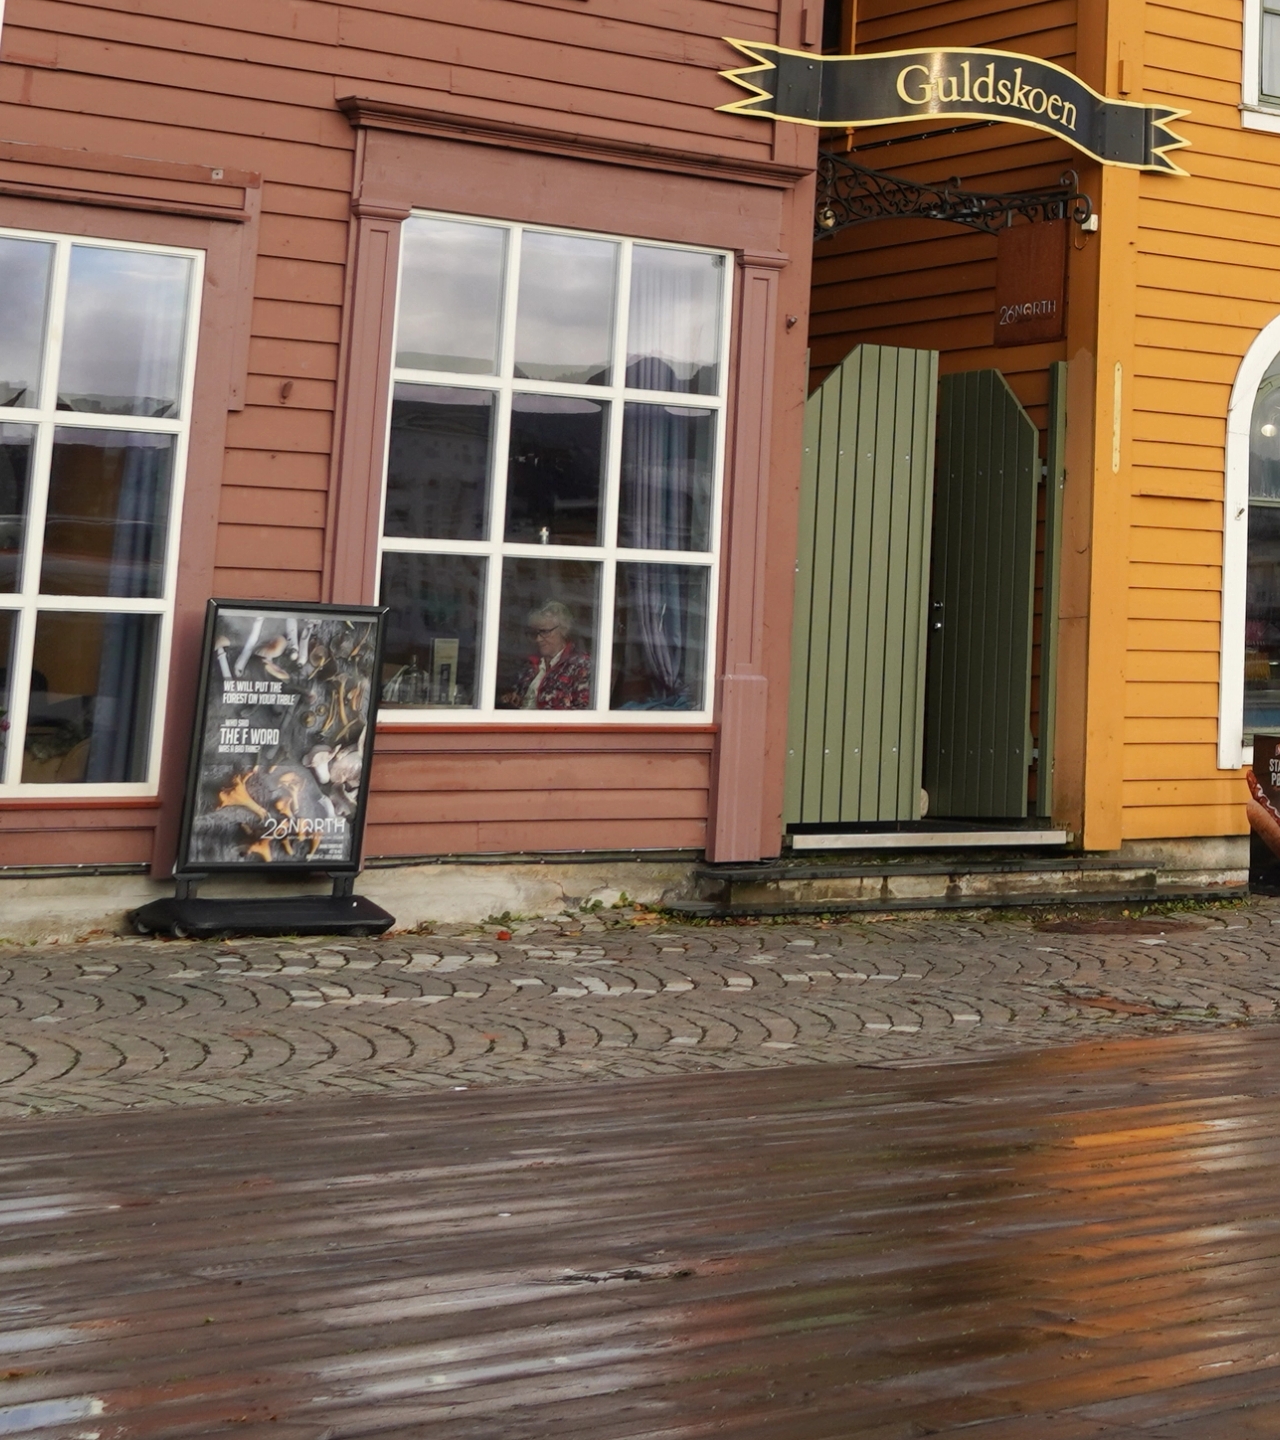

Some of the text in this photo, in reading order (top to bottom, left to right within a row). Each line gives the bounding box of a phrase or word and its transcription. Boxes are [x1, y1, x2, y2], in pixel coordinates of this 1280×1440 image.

[896, 61, 1077, 131] Guldskoen
[224, 680, 283, 693] WE WILL PUT THE
[222, 693, 295, 706] FOREST ON YOUR TABLE
[220, 728, 280, 745] THE F WORD
